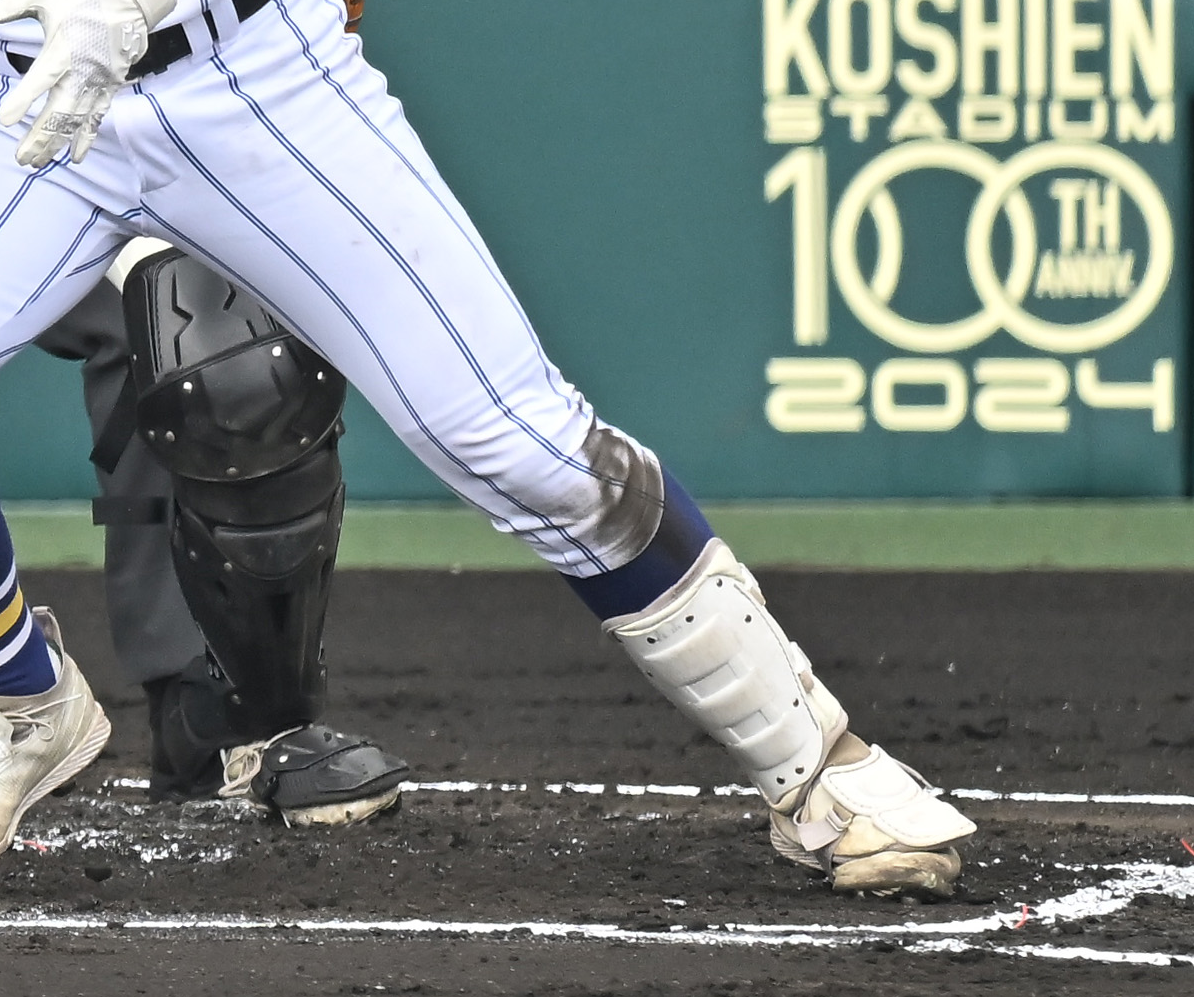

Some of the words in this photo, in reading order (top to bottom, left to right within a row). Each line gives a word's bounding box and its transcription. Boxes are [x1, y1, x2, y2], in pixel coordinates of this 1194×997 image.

[763, 94, 1174, 143] STADIUM
[1049, 178, 1121, 253] TH
[764, 357, 1175, 433] 2024
